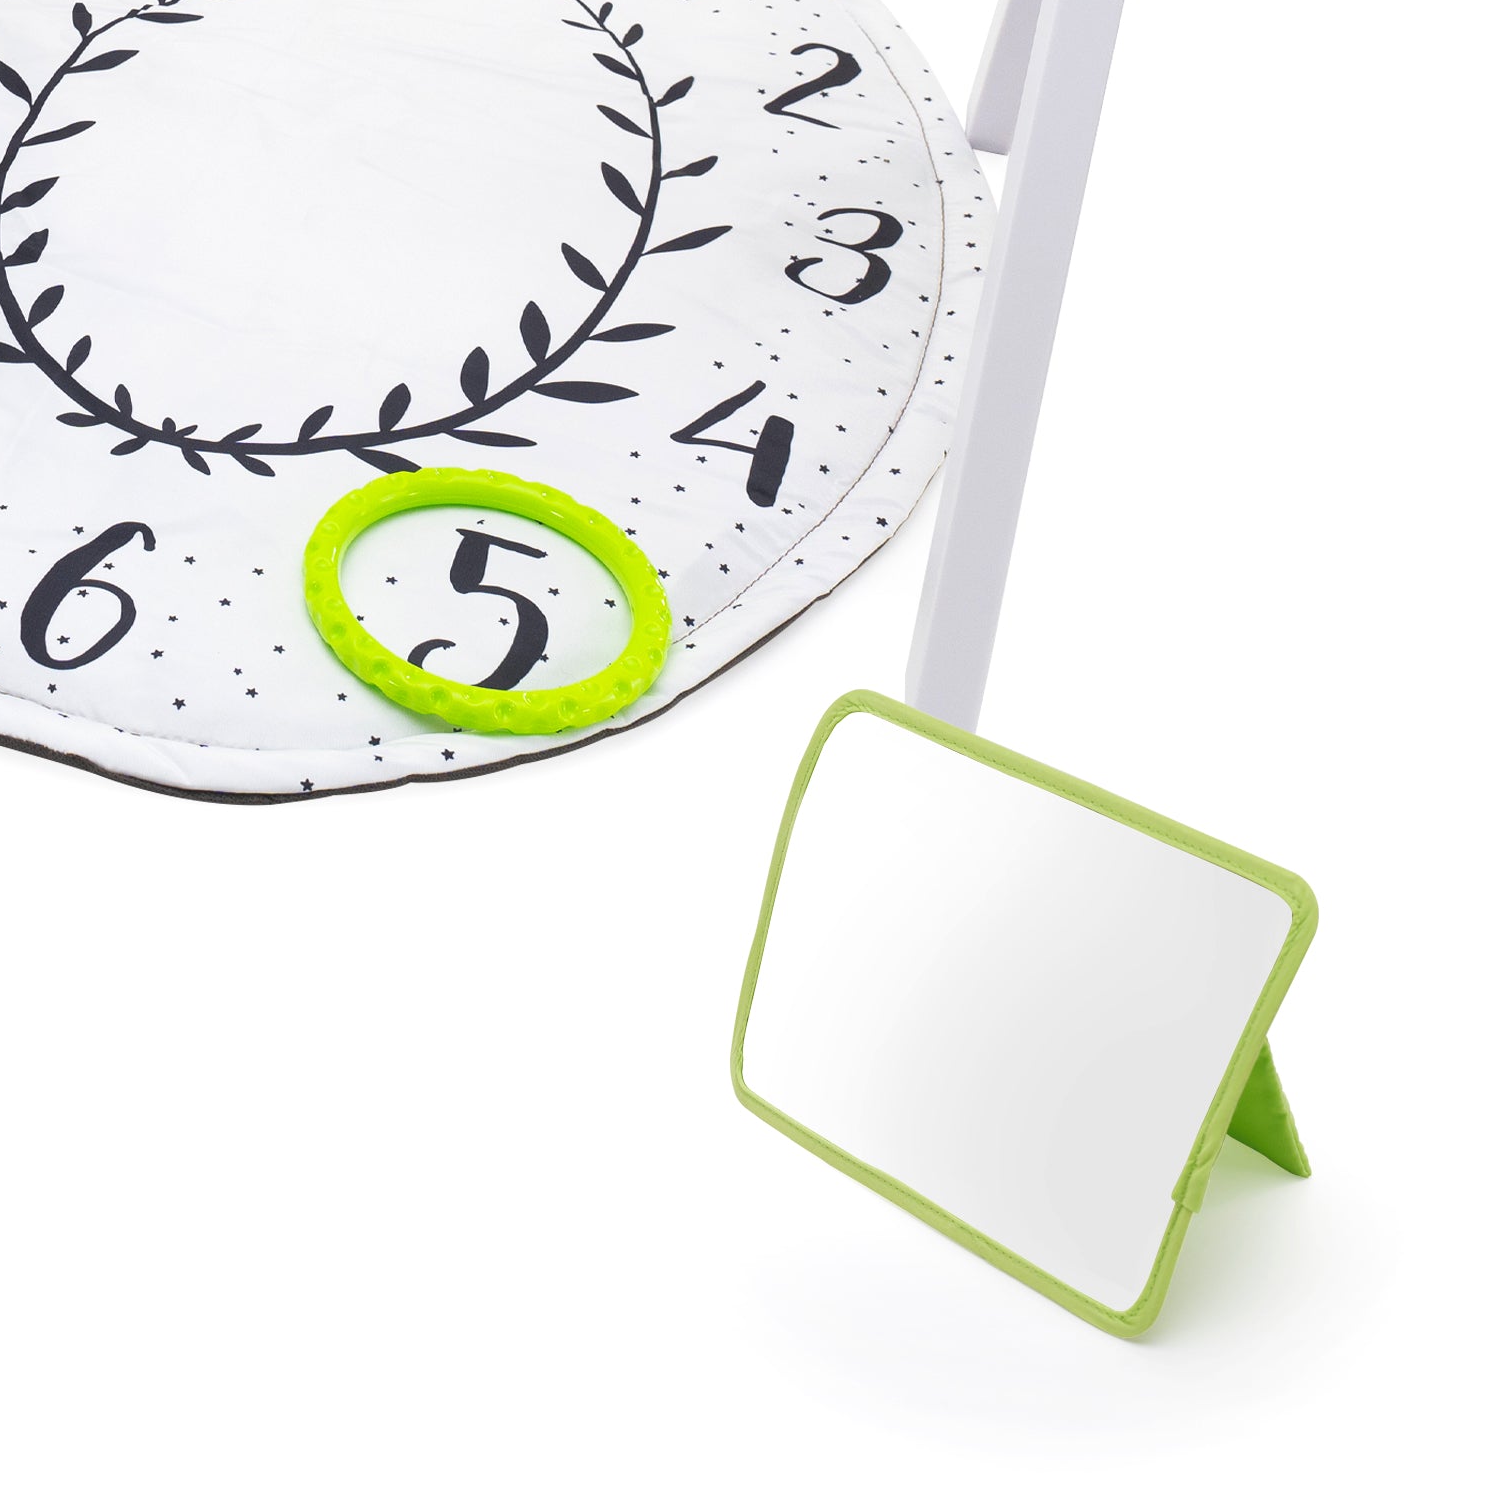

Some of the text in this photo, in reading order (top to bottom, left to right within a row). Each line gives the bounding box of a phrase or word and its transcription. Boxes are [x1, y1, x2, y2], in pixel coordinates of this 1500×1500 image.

[764, 43, 862, 129] 2
[785, 207, 904, 304] 3
[669, 380, 794, 508] 4
[21, 521, 156, 670] 6
[407, 528, 549, 691] 5
